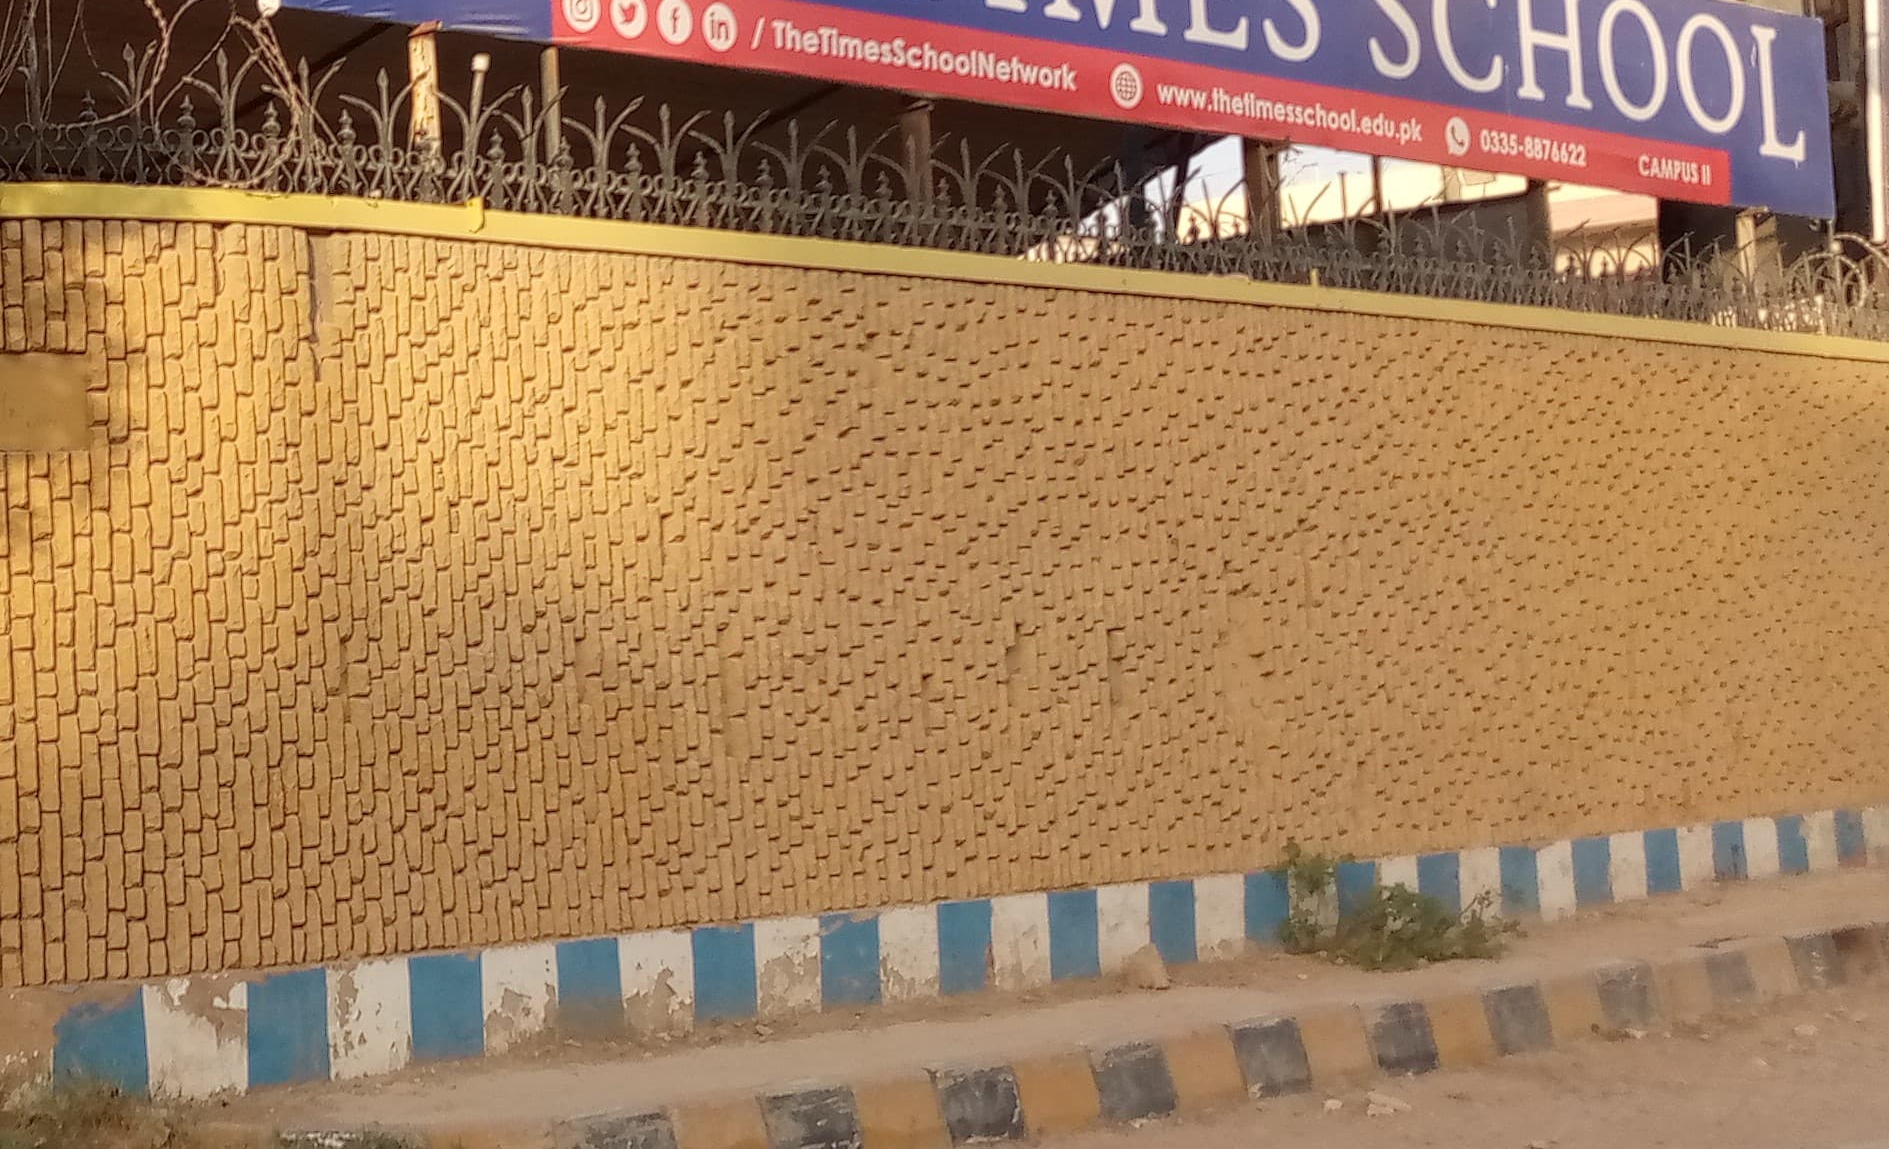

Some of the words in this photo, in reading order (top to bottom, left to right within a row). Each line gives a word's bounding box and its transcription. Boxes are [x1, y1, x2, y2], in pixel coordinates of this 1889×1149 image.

[772, 19, 1077, 91] TheTimesSchoolNetwork
[1157, 83, 1423, 145] www.thetimesschool.edu.pk
[1480, 129, 1586, 166] 0335-8876622
[1638, 156, 1698, 183] CAMPUS
[1701, 164, 1711, 186] II
